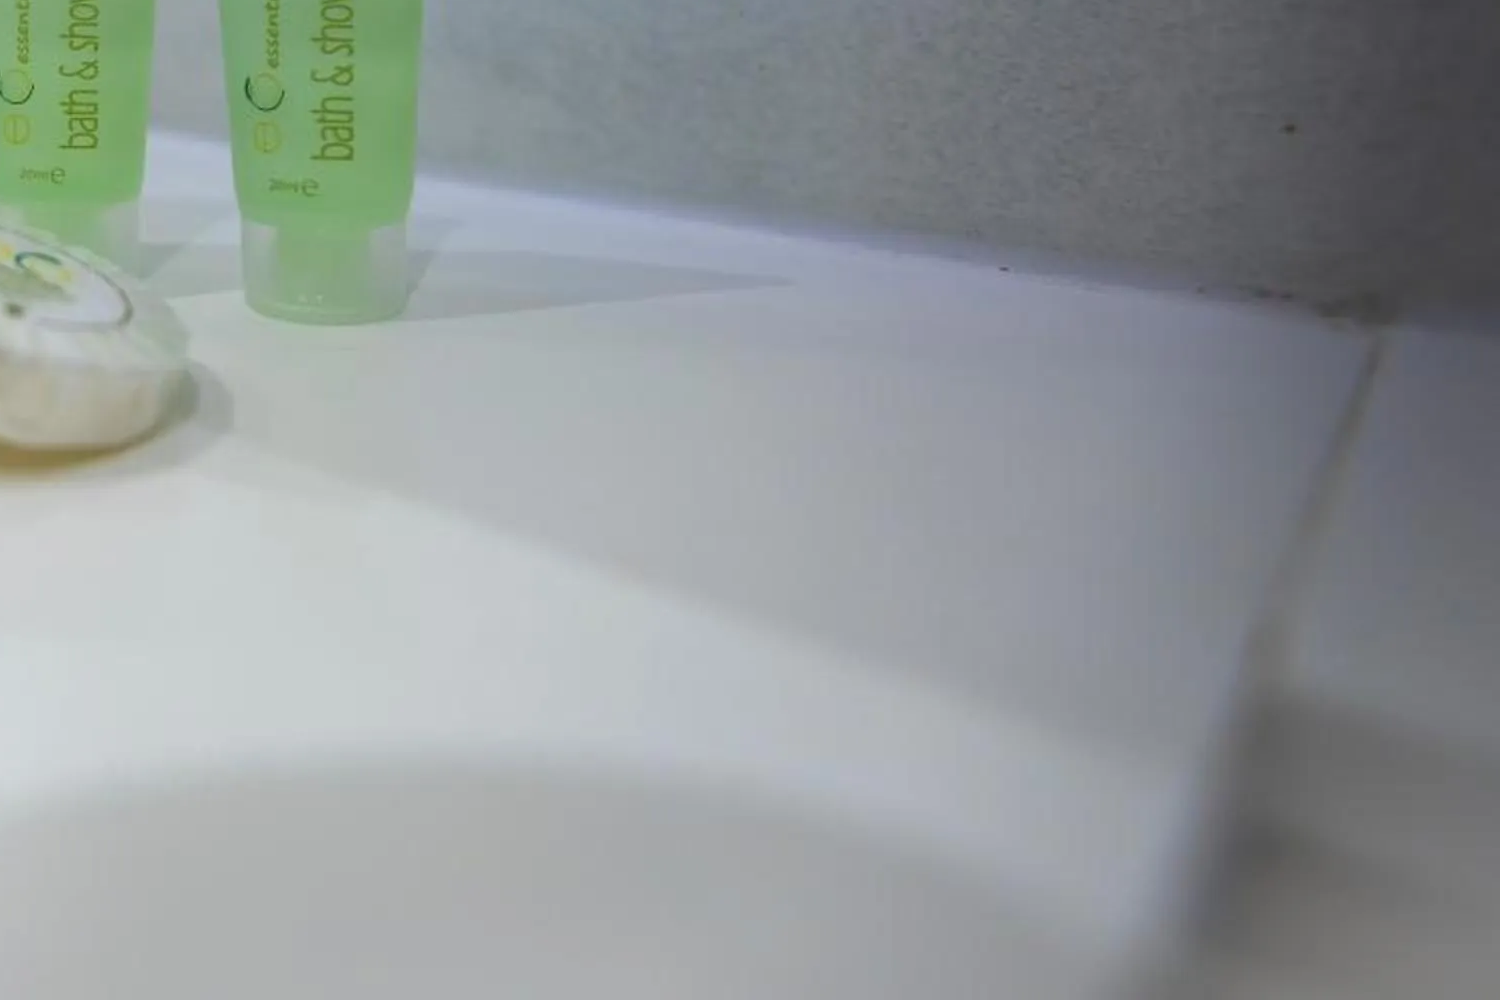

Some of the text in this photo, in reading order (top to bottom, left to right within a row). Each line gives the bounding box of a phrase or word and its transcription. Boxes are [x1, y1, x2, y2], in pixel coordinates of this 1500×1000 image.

[60, 64, 99, 83] &
[310, 65, 354, 87] &
[59, 85, 99, 151] bath
[310, 96, 354, 162] bath
